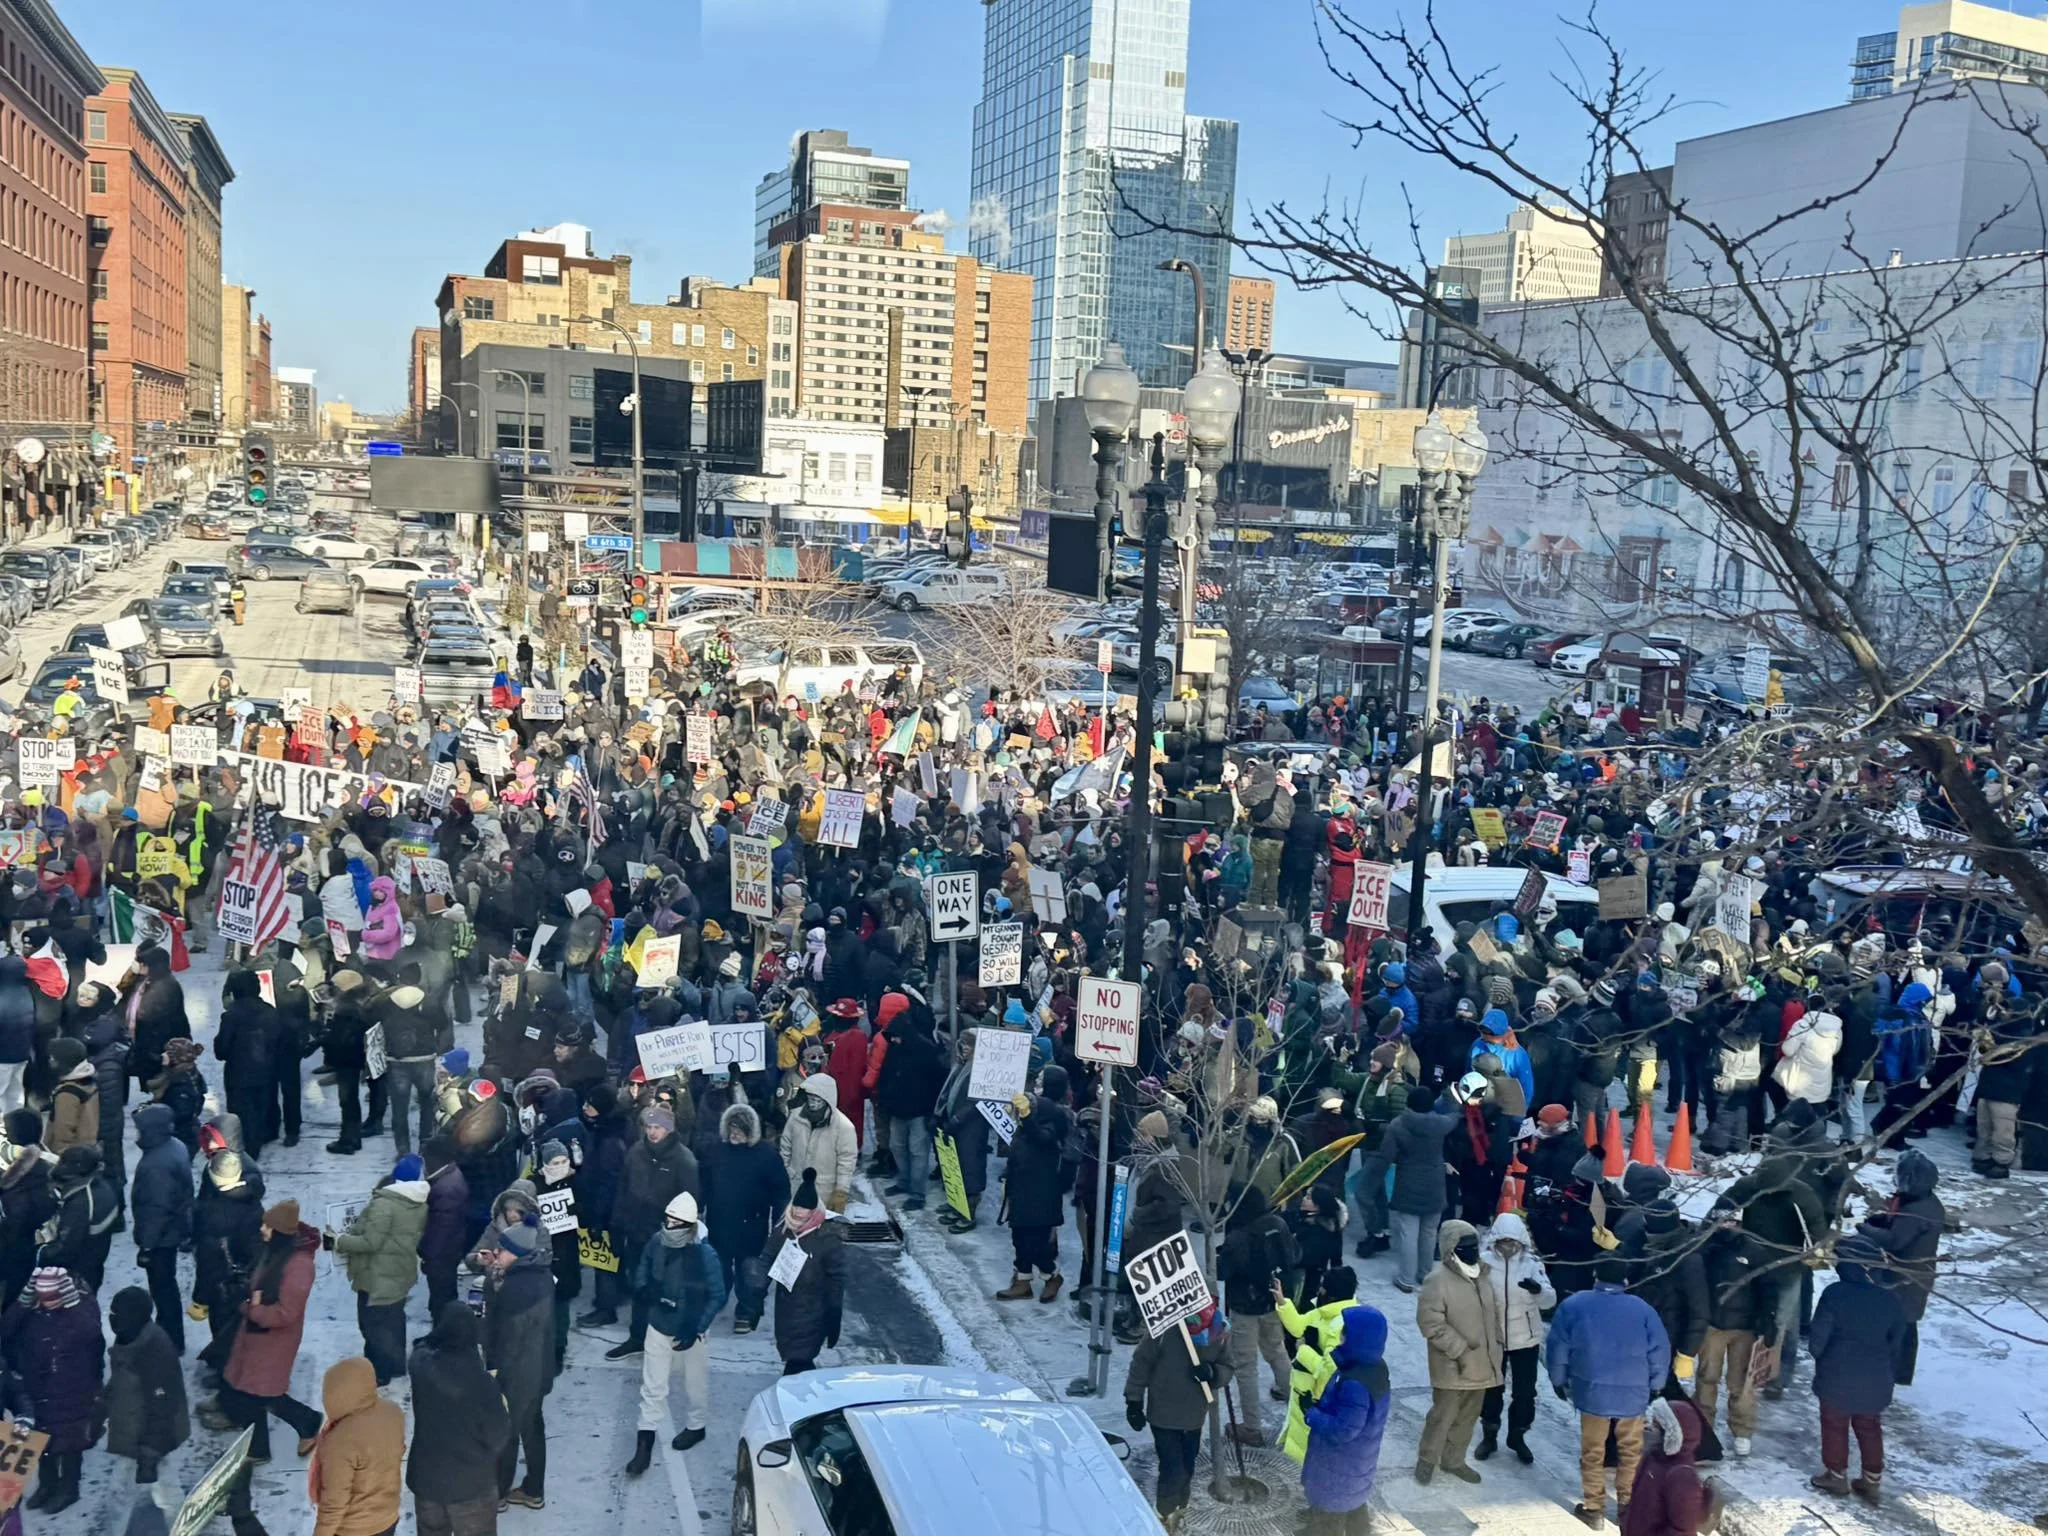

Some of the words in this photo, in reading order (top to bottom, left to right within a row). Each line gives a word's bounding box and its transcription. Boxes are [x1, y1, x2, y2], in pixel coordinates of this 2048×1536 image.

[1268, 414, 1350, 449] Dreamgirls
[618, 539, 627, 548] St
[632, 631, 644, 640] NO
[92, 657, 123, 674] FUCK
[629, 670, 645, 678] ONE
[101, 676, 121, 690] ICE
[524, 704, 561, 715] POLICE
[303, 714, 321, 731] ICE
[22, 741, 54, 759] STOP
[299, 768, 341, 818] ICE
[755, 804, 785, 824] ICE
[820, 822, 853, 845] ALL
[746, 853, 768, 864] PEOPLE
[757, 846, 767, 855] TO
[736, 880, 750, 890] NOT
[752, 883, 766, 893] THE
[937, 878, 972, 893] ONE
[1356, 874, 1385, 900] ICE
[224, 880, 256, 910] STOP
[736, 888, 766, 909] KING
[937, 896, 972, 913] WAY
[1352, 898, 1385, 924] OUT!
[991, 933, 1019, 943] FOUGHT
[981, 943, 1021, 956] GESTAPO
[982, 959, 995, 970] SO
[999, 956, 1019, 967] WILL
[996, 967, 1004, 983] I
[1097, 987, 1121, 1009] NO
[1080, 1013, 1135, 1036] STOPPING
[711, 1030, 765, 1065] ESIST
[978, 1029, 1007, 1051] RISE
[1012, 1034, 1030, 1052] UP
[990, 1052, 1001, 1062] DO
[1005, 1053, 1017, 1063] IT
[970, 1082, 995, 1097] TIMES
[540, 1198, 571, 1216] OUT
[593, 1251, 611, 1265] ICE
[1129, 1236, 1189, 1296] STOP
[1141, 1296, 1160, 1317] ICE
[1158, 1271, 1202, 1304] TERROR
[1149, 1286, 1206, 1328] NOW!
